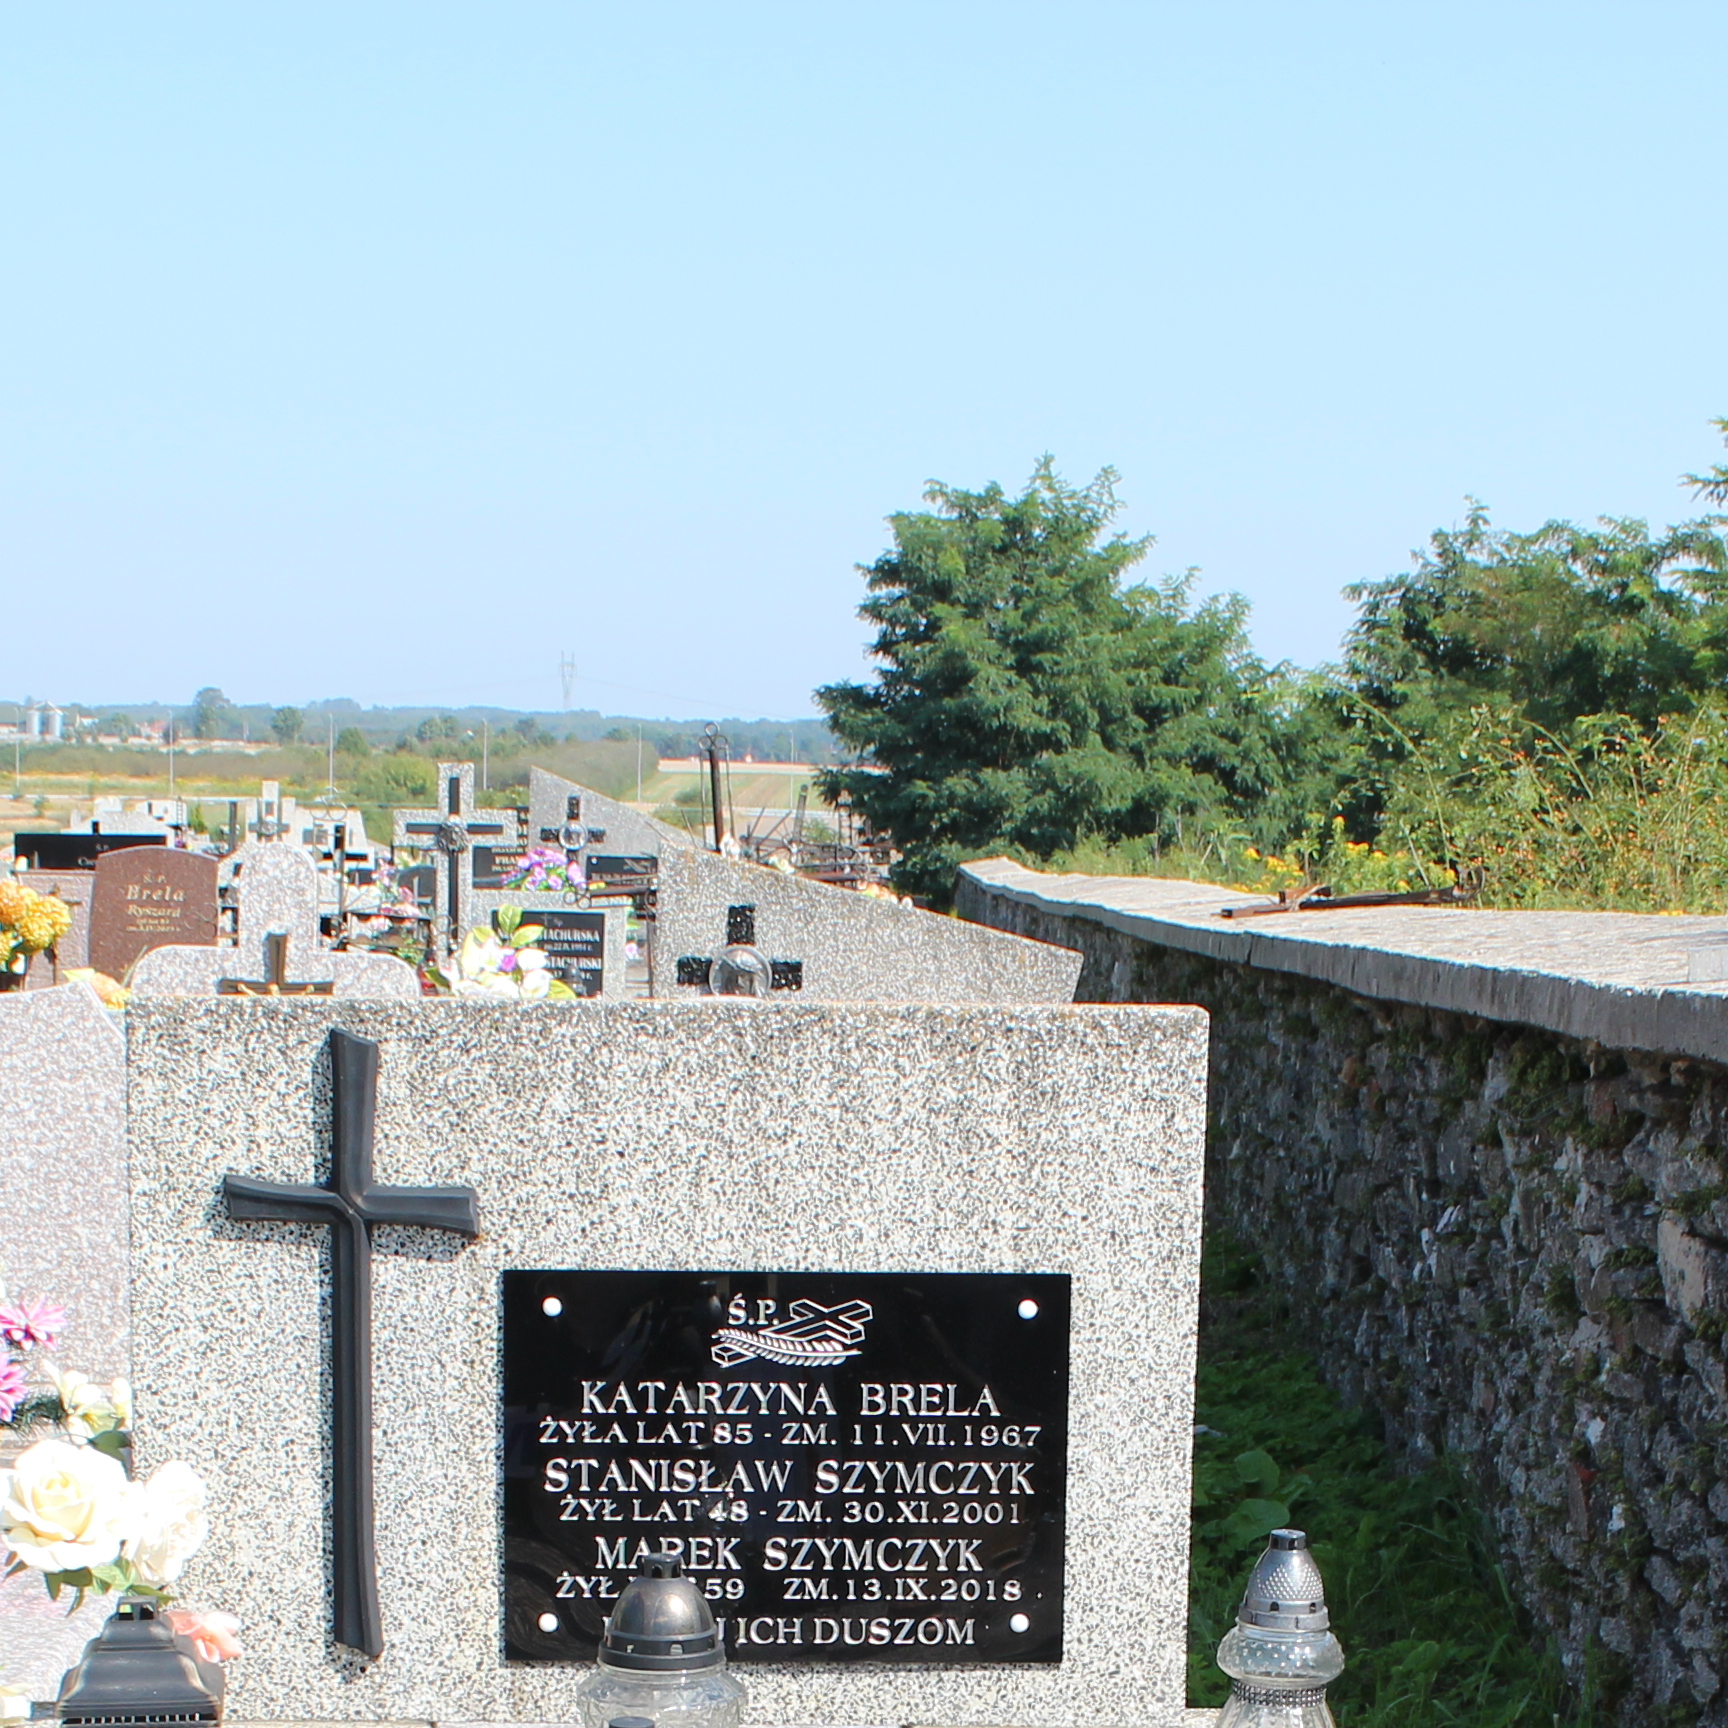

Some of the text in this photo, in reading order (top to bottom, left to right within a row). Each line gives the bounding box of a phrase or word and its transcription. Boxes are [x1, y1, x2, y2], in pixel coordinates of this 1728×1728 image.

[126, 885, 185, 901] Brela
[127, 904, 181, 918] Ryszard
[727, 1292, 780, 1326] Ś.P.
[581, 1380, 1001, 1417] KATARZYNA BRELA
[539, 1415, 629, 1443] ŻYŁA
[636, 1421, 705, 1444] LAT
[712, 1422, 754, 1445] 85
[781, 1422, 837, 1445] ZM.
[853, 1423, 1042, 1447] 11.VII.1967
[543, 1458, 1035, 1495] STANISŁAW SZYMCZYK
[559, 1493, 624, 1521] ŻYŁ
[632, 1499, 701, 1522] LAT
[707, 1500, 750, 1522] 48
[776, 1500, 833, 1523] ZM.
[842, 1501, 1020, 1524] 30.XI.2001
[762, 1537, 983, 1571] SZYMCZYK
[555, 1571, 620, 1598] ŻYŁ
[704, 1577, 746, 1600] 59
[736, 1616, 804, 1645] ICH
[813, 1617, 976, 1646] DUSZOM
